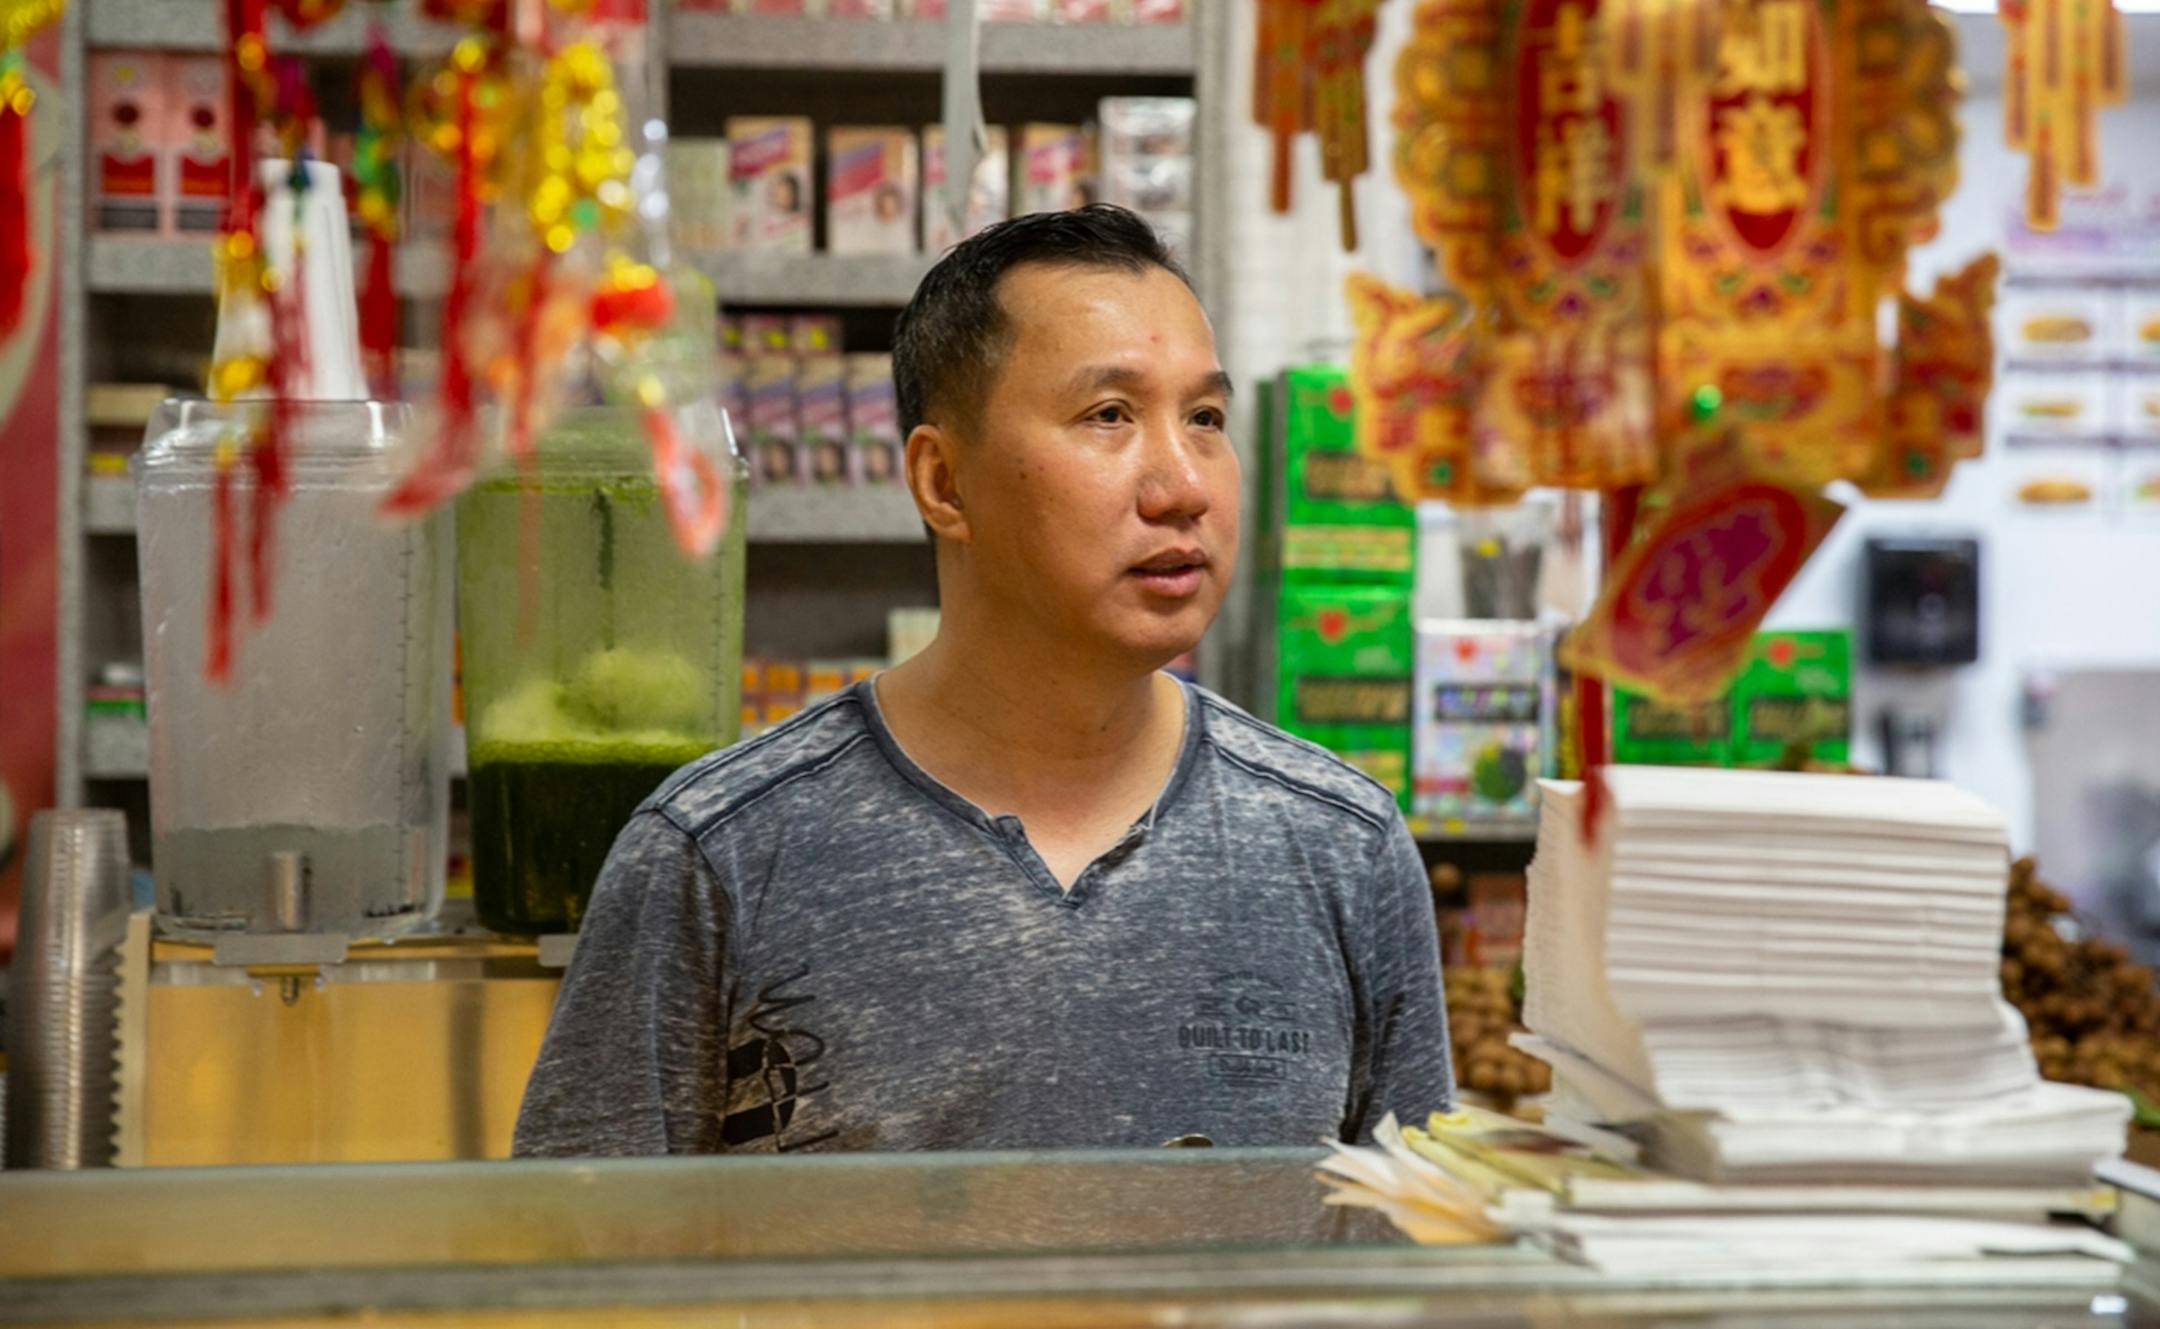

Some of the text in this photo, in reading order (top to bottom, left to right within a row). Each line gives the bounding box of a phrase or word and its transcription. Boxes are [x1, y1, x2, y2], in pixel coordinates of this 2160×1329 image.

[1713, 0, 1811, 209] 如意
[1237, 1027, 1261, 1050] TO
[1266, 1030, 1311, 1054] LAST
